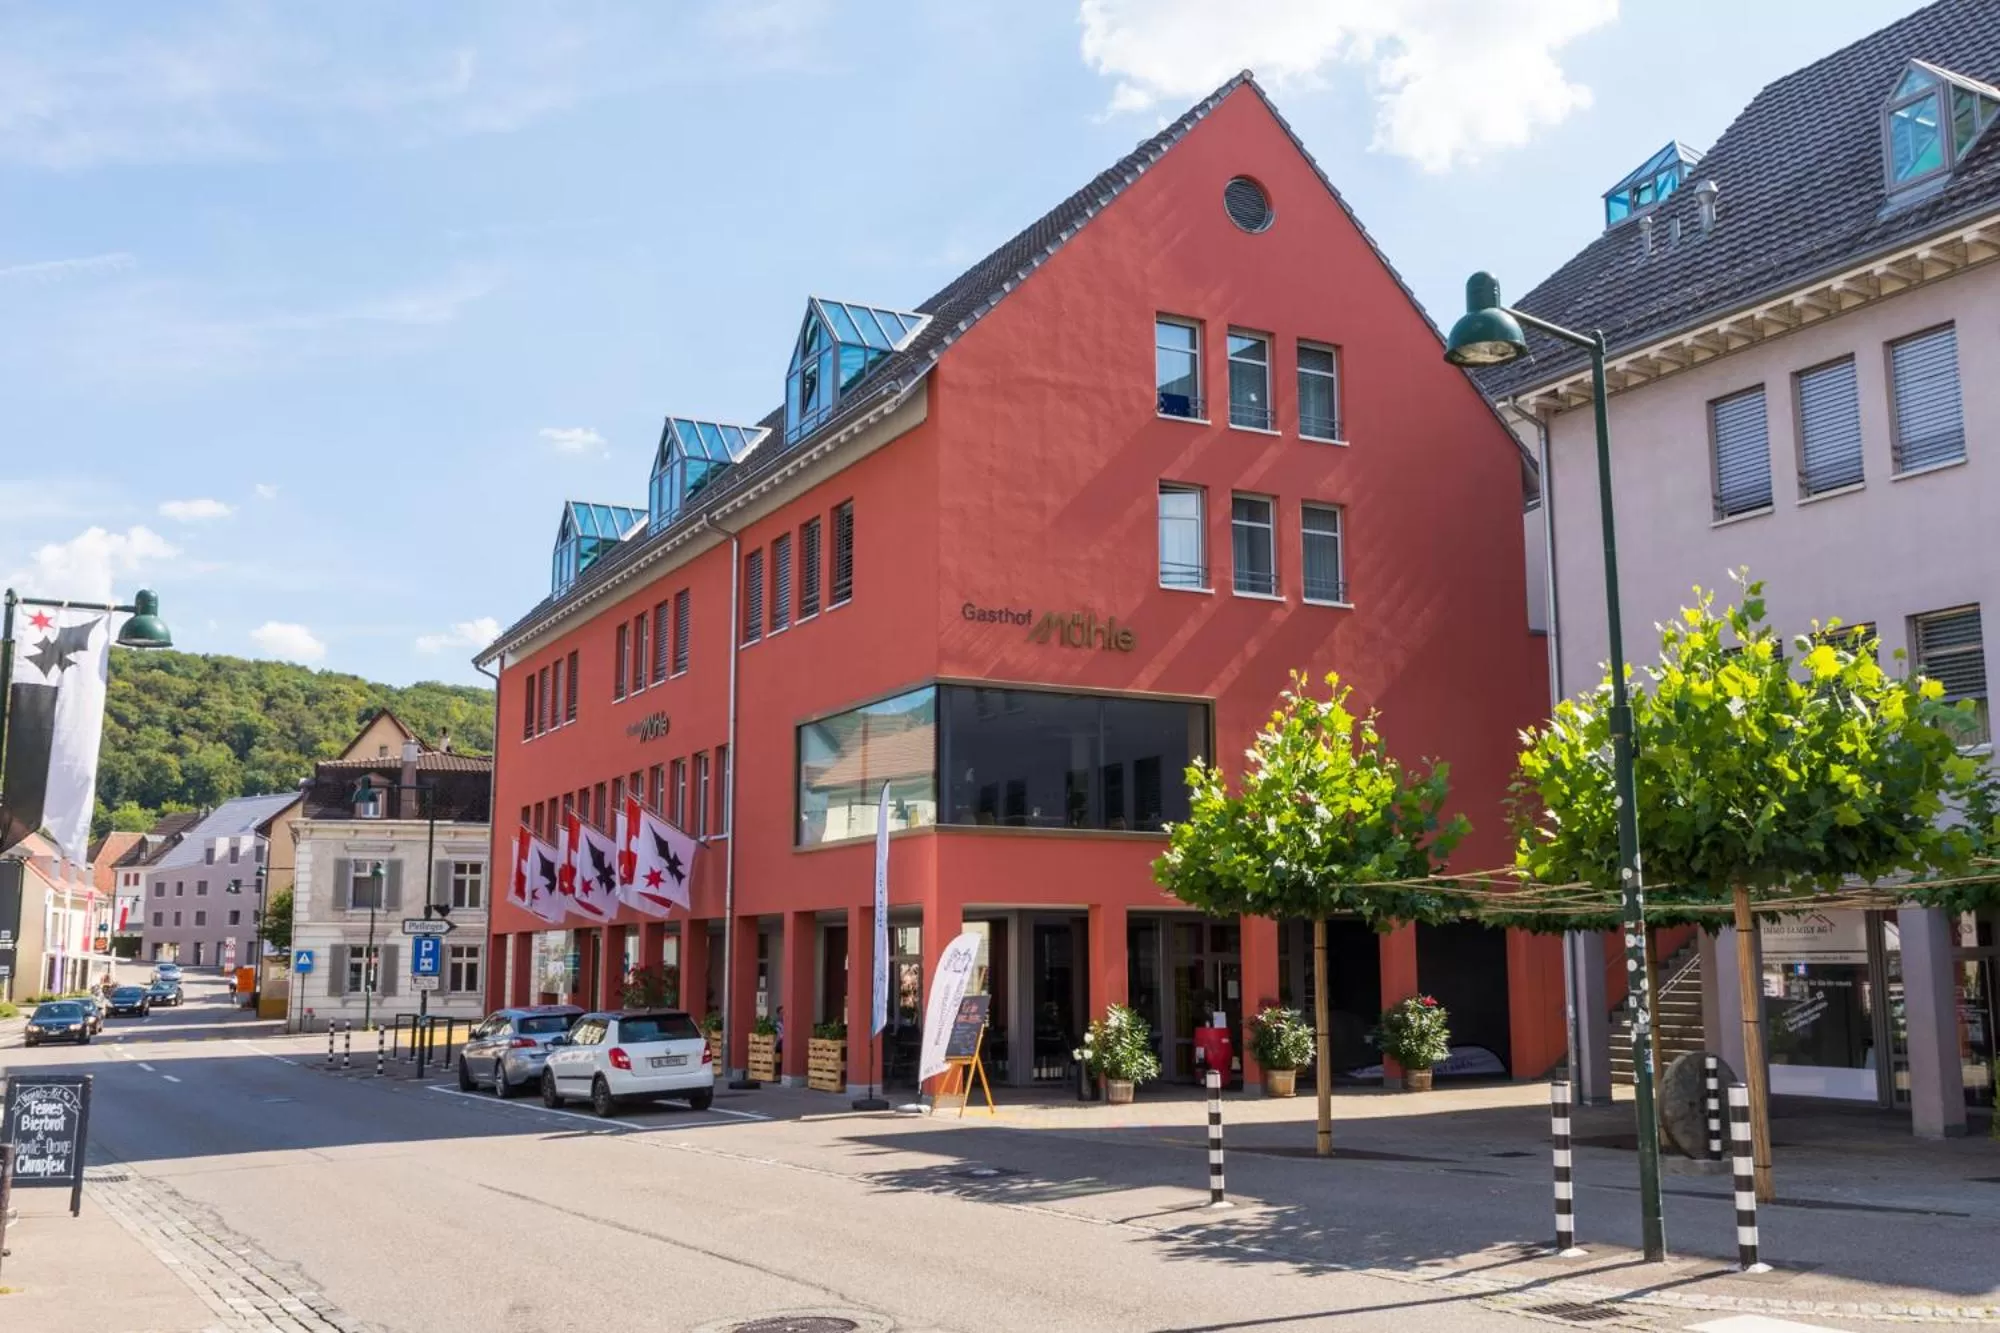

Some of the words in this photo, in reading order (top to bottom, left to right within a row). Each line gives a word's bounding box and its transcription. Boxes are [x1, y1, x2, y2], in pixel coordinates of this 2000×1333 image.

[961, 603, 1033, 626] Gasthof
[1025, 609, 1137, 652] Mühle
[422, 940, 433, 957] P
[30, 1099, 64, 1115] Feines
[21, 1114, 66, 1132] Bierbrot
